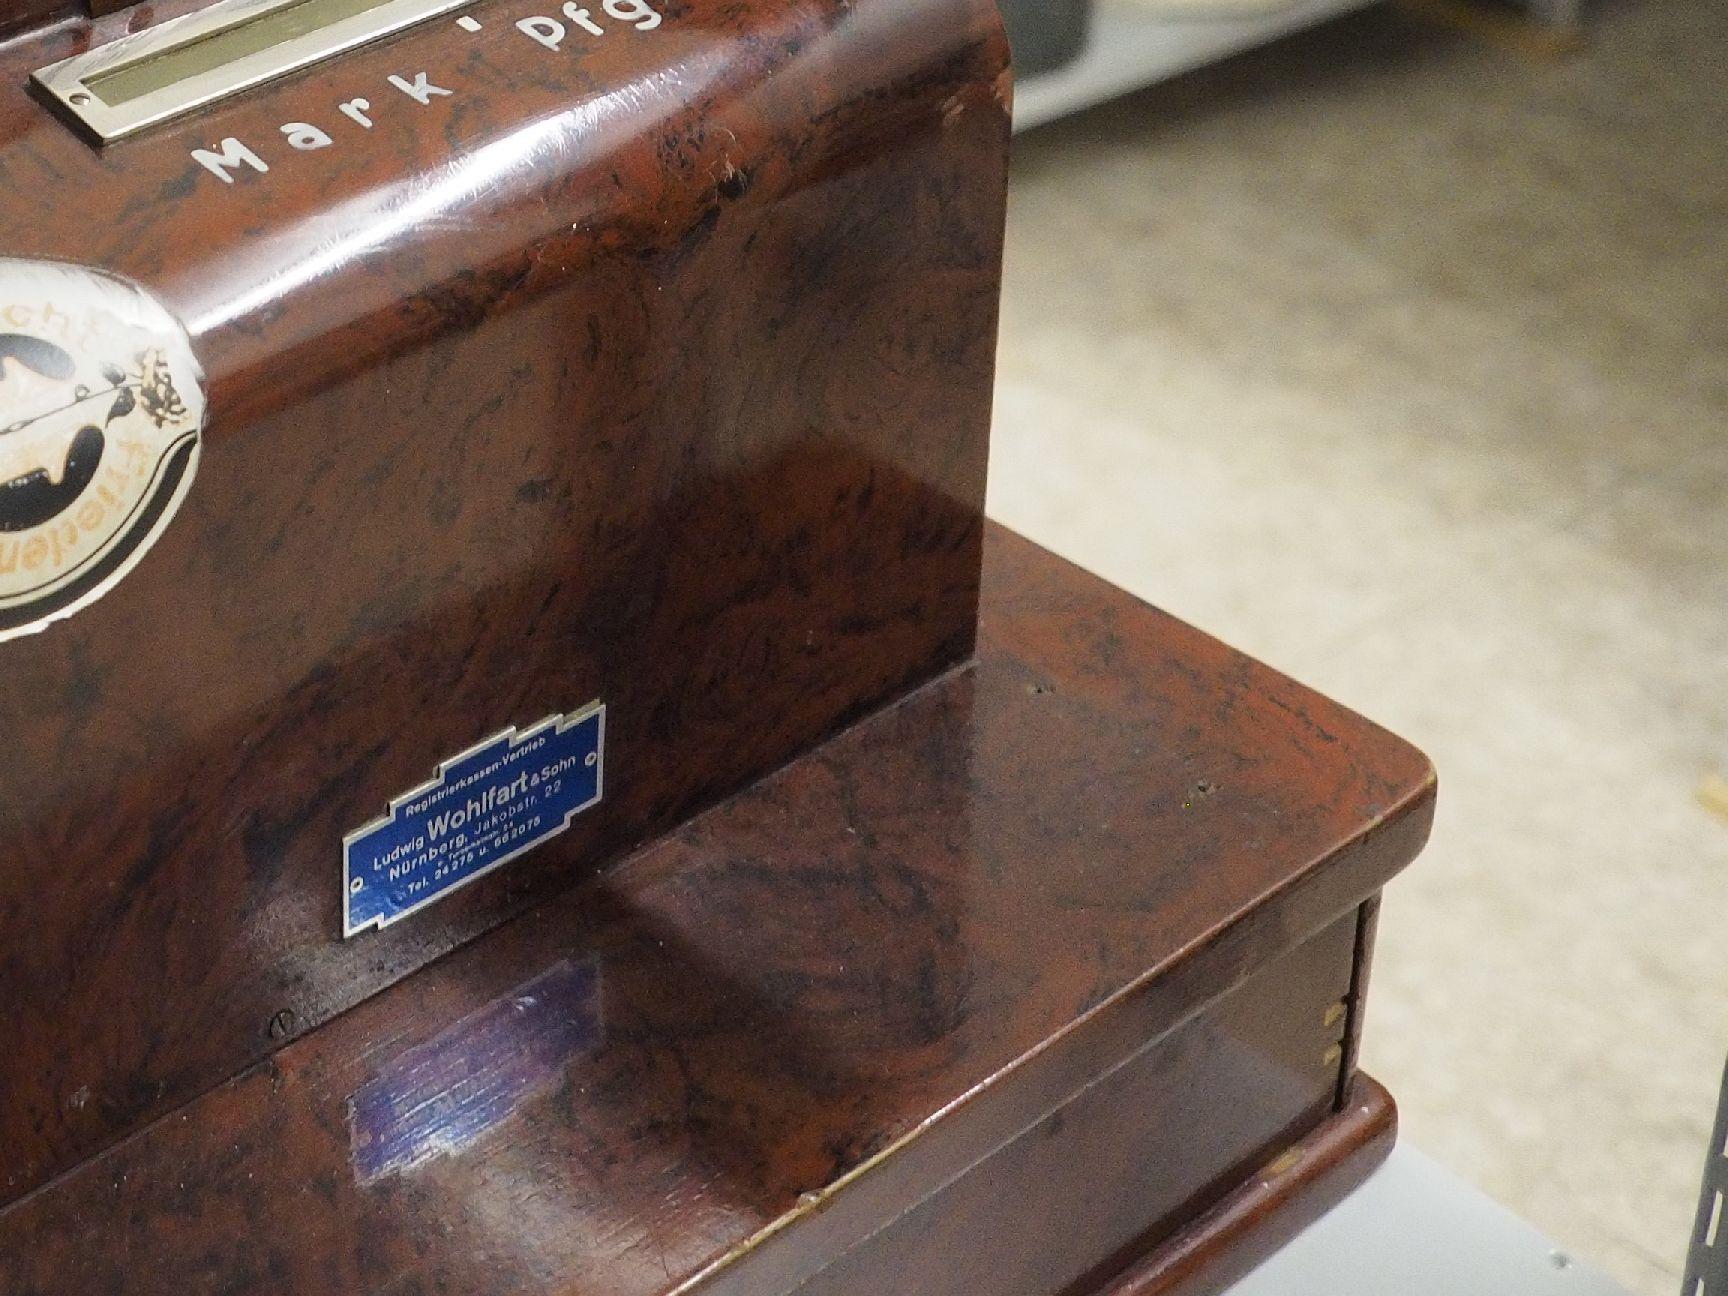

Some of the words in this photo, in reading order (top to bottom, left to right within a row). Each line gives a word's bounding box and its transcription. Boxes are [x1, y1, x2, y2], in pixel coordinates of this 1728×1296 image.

[189, 70, 454, 185] Mark
[373, 835, 424, 871] Ludwig
[427, 770, 529, 841] Wohlfart
[405, 736, 546, 818] Registrierkassen-Vertrieb
[407, 876, 429, 894] Tel.
